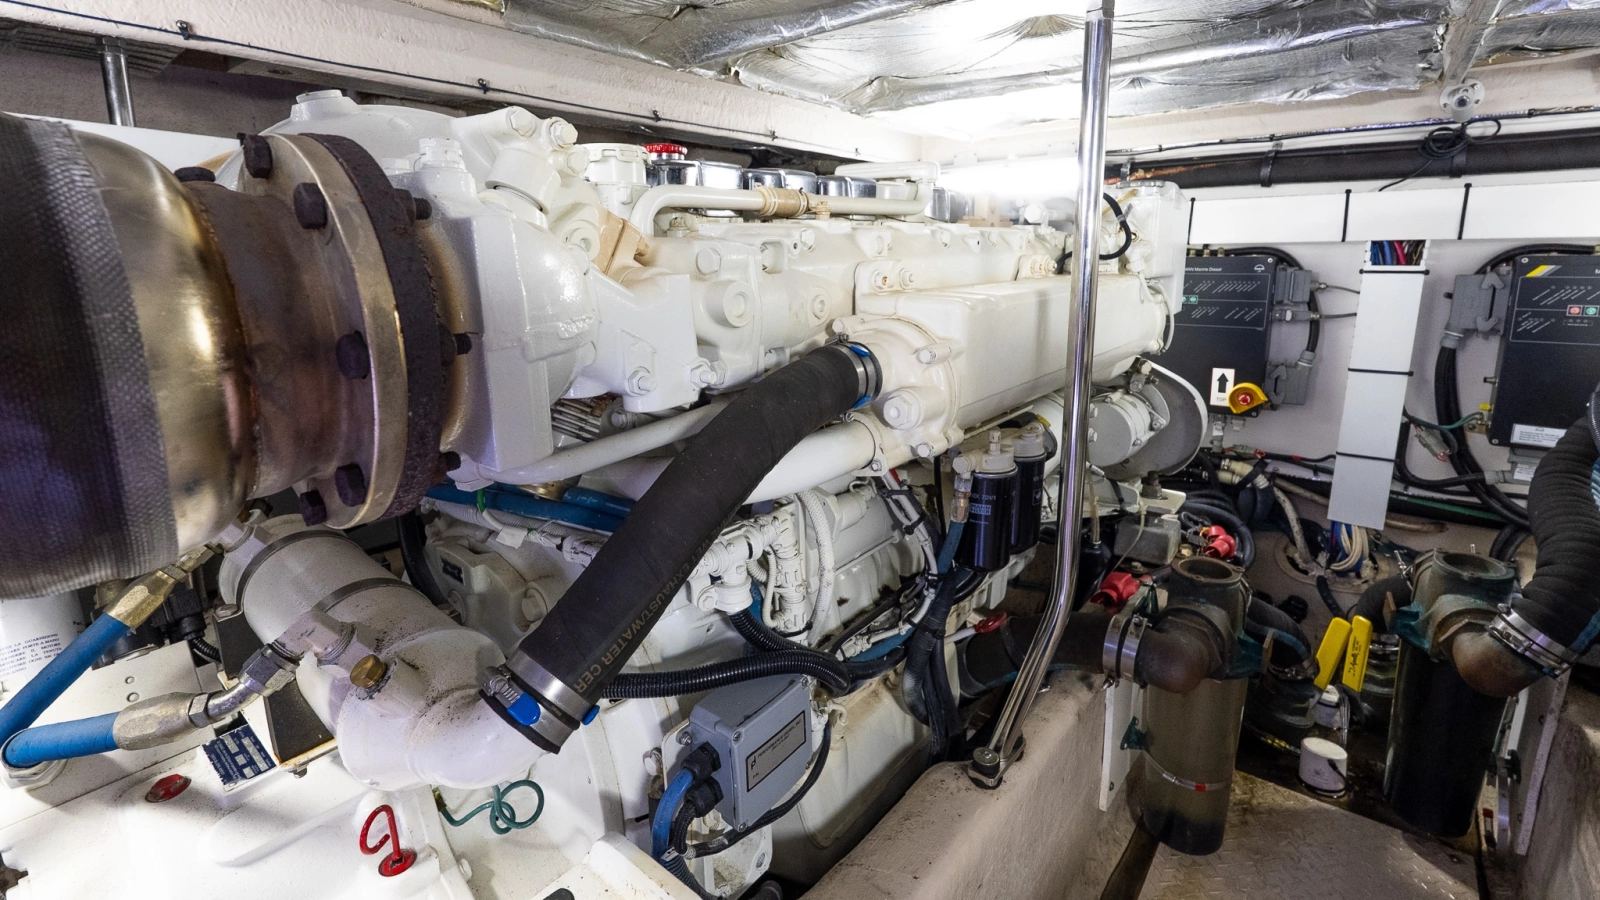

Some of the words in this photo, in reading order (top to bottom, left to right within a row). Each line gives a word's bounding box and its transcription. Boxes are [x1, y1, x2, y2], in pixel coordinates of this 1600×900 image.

[691, 538, 711, 562] WET
[601, 562, 690, 666] EXHAUST/WATER
[41, 642, 62, 650] MOTORE
[573, 663, 602, 693] CER
